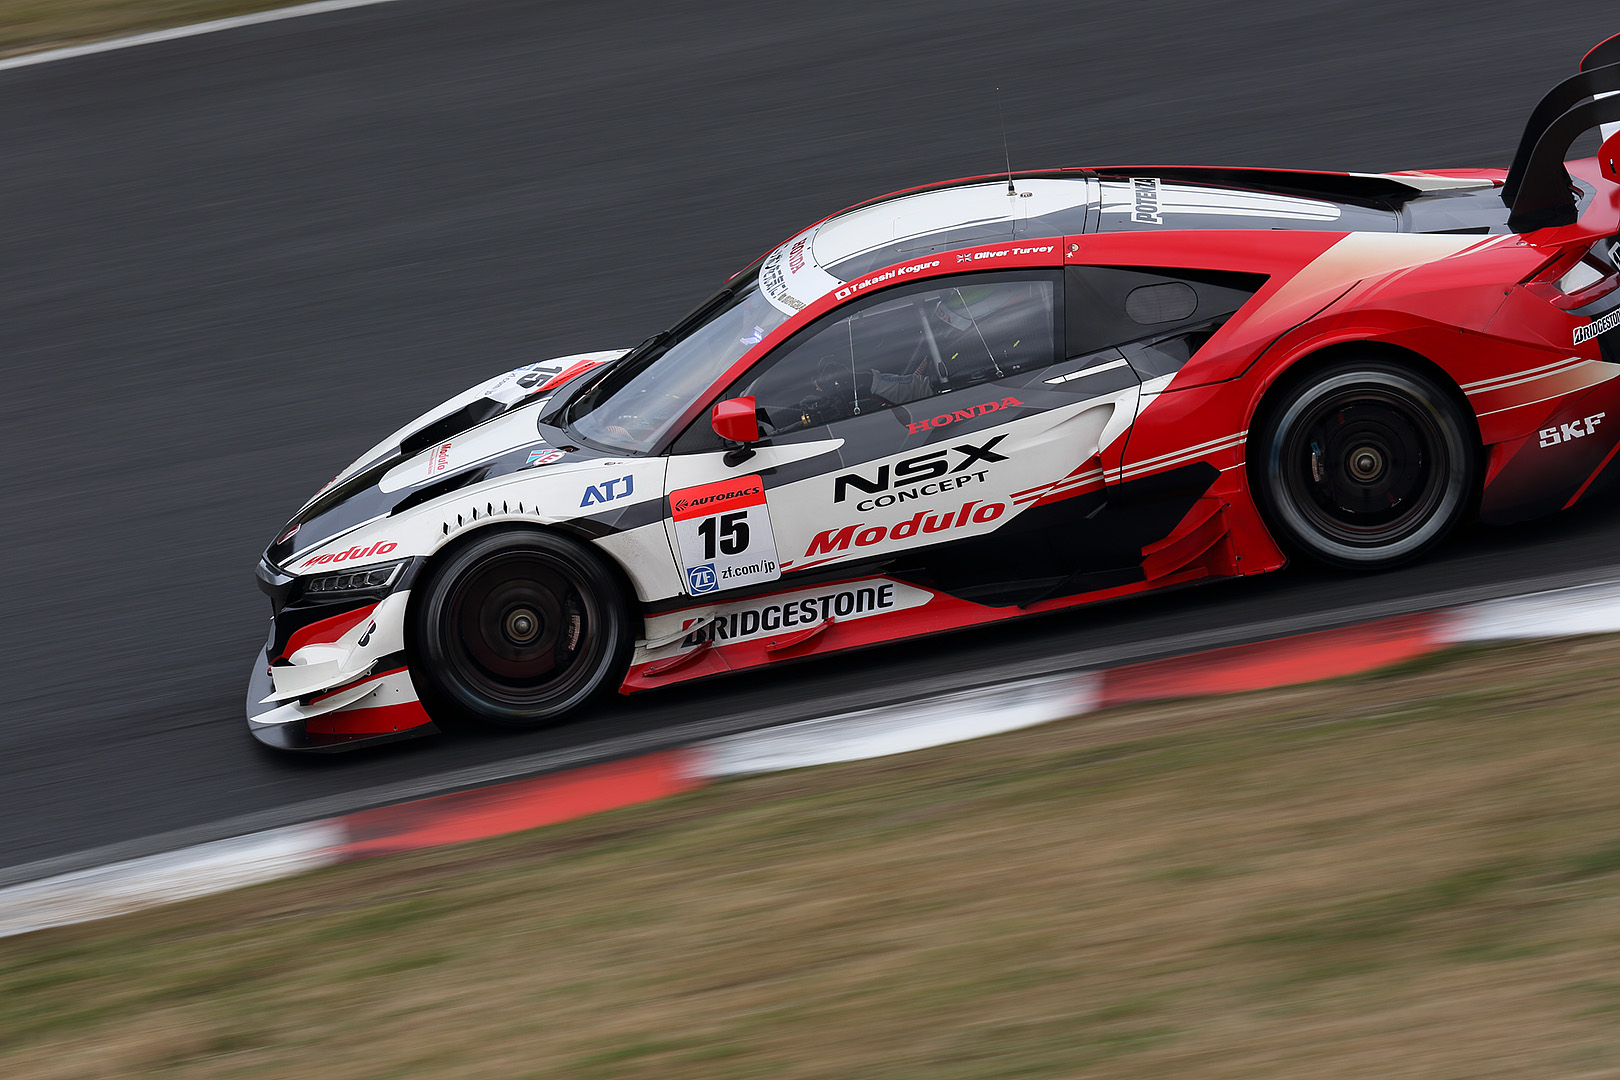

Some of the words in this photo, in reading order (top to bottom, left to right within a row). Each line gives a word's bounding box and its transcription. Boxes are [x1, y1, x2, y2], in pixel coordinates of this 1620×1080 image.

[1134, 178, 1158, 222] POTENZA
[789, 237, 807, 274] HONDA
[974, 250, 1009, 260] Oliver
[1012, 245, 1054, 256] Turvey
[850, 270, 895, 293] Takashi
[898, 260, 940, 276] Kogure
[516, 366, 563, 389] 15
[906, 396, 1024, 435] HONDA
[1539, 412, 1606, 448] SKF
[437, 443, 452, 471] Modulo
[834, 433, 1010, 503] NSX
[580, 474, 634, 508] ATJ
[690, 486, 760, 507] AUTOBACS
[856, 470, 989, 512] CONCEPT
[698, 510, 750, 560] 15
[804, 500, 1006, 558] Modulo
[300, 540, 398, 569] Modulo
[721, 560, 776, 579] zf.com/jp
[680, 584, 894, 648] BRIDGESTONE
